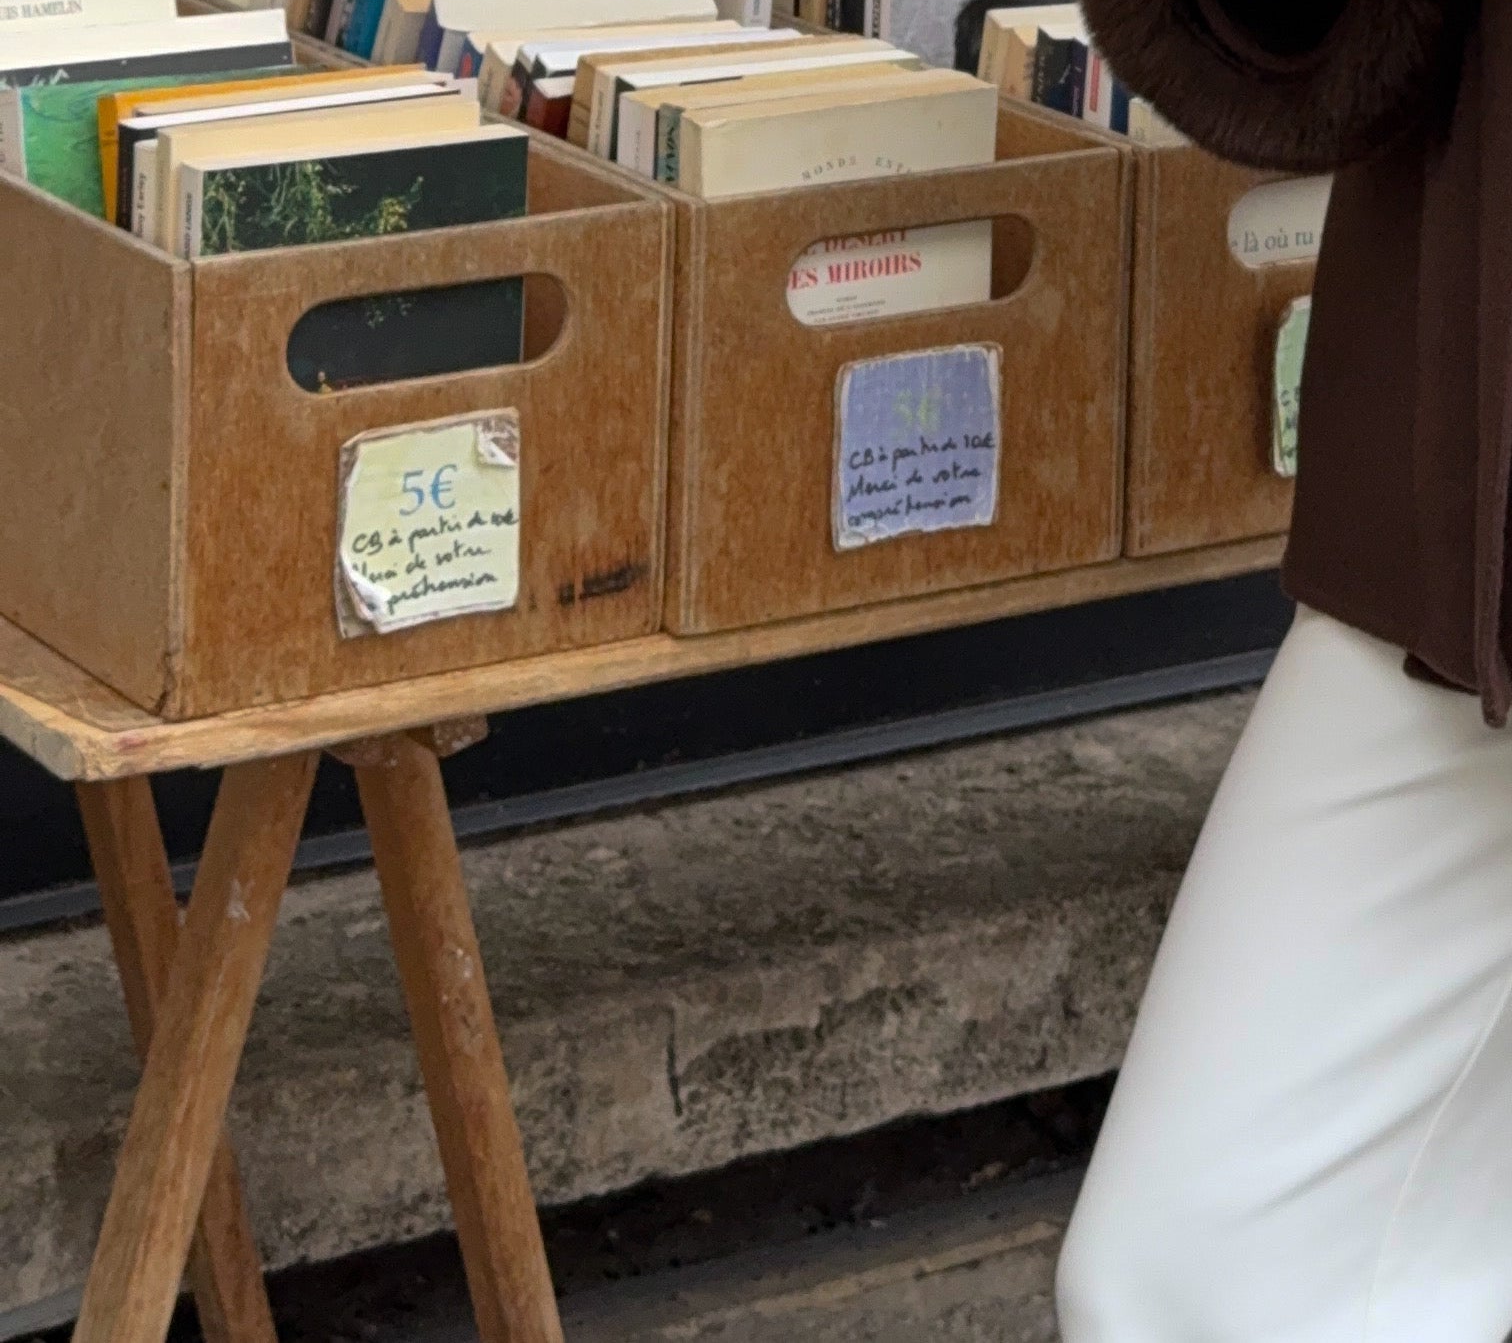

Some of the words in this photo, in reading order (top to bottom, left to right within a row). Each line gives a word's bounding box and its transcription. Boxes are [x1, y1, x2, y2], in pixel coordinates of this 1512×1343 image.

[1264, 228, 1290, 252] où
[788, 266, 818, 291] ES
[826, 250, 923, 286] MIROIRS
[399, 463, 459, 517] 5€
[352, 529, 384, 556] CB
